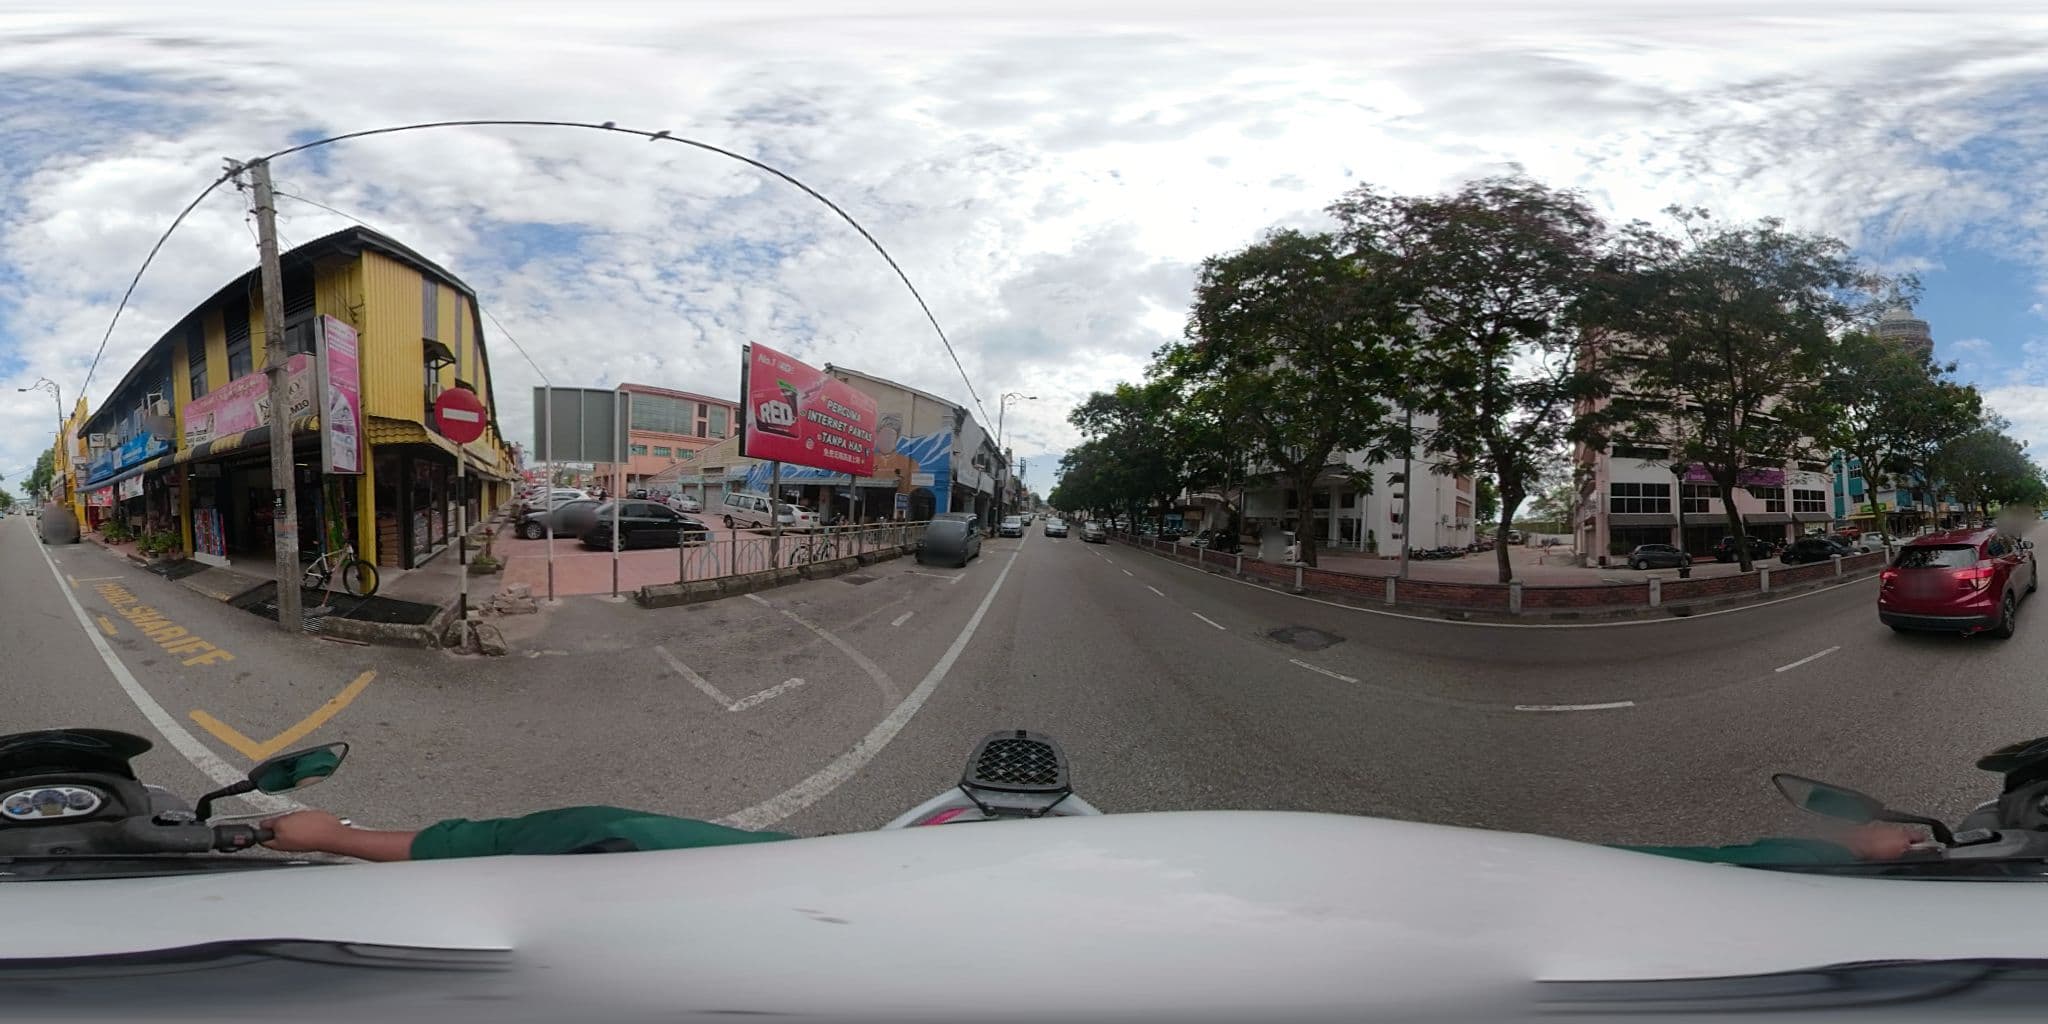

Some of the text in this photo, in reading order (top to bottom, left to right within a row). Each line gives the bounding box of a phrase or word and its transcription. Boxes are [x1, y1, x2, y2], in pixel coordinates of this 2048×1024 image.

[827, 399, 861, 421] PERCUMA
[807, 409, 847, 432] INTERNET
[848, 425, 872, 442] PANTAS
[822, 432, 863, 453] TANPA HAD
